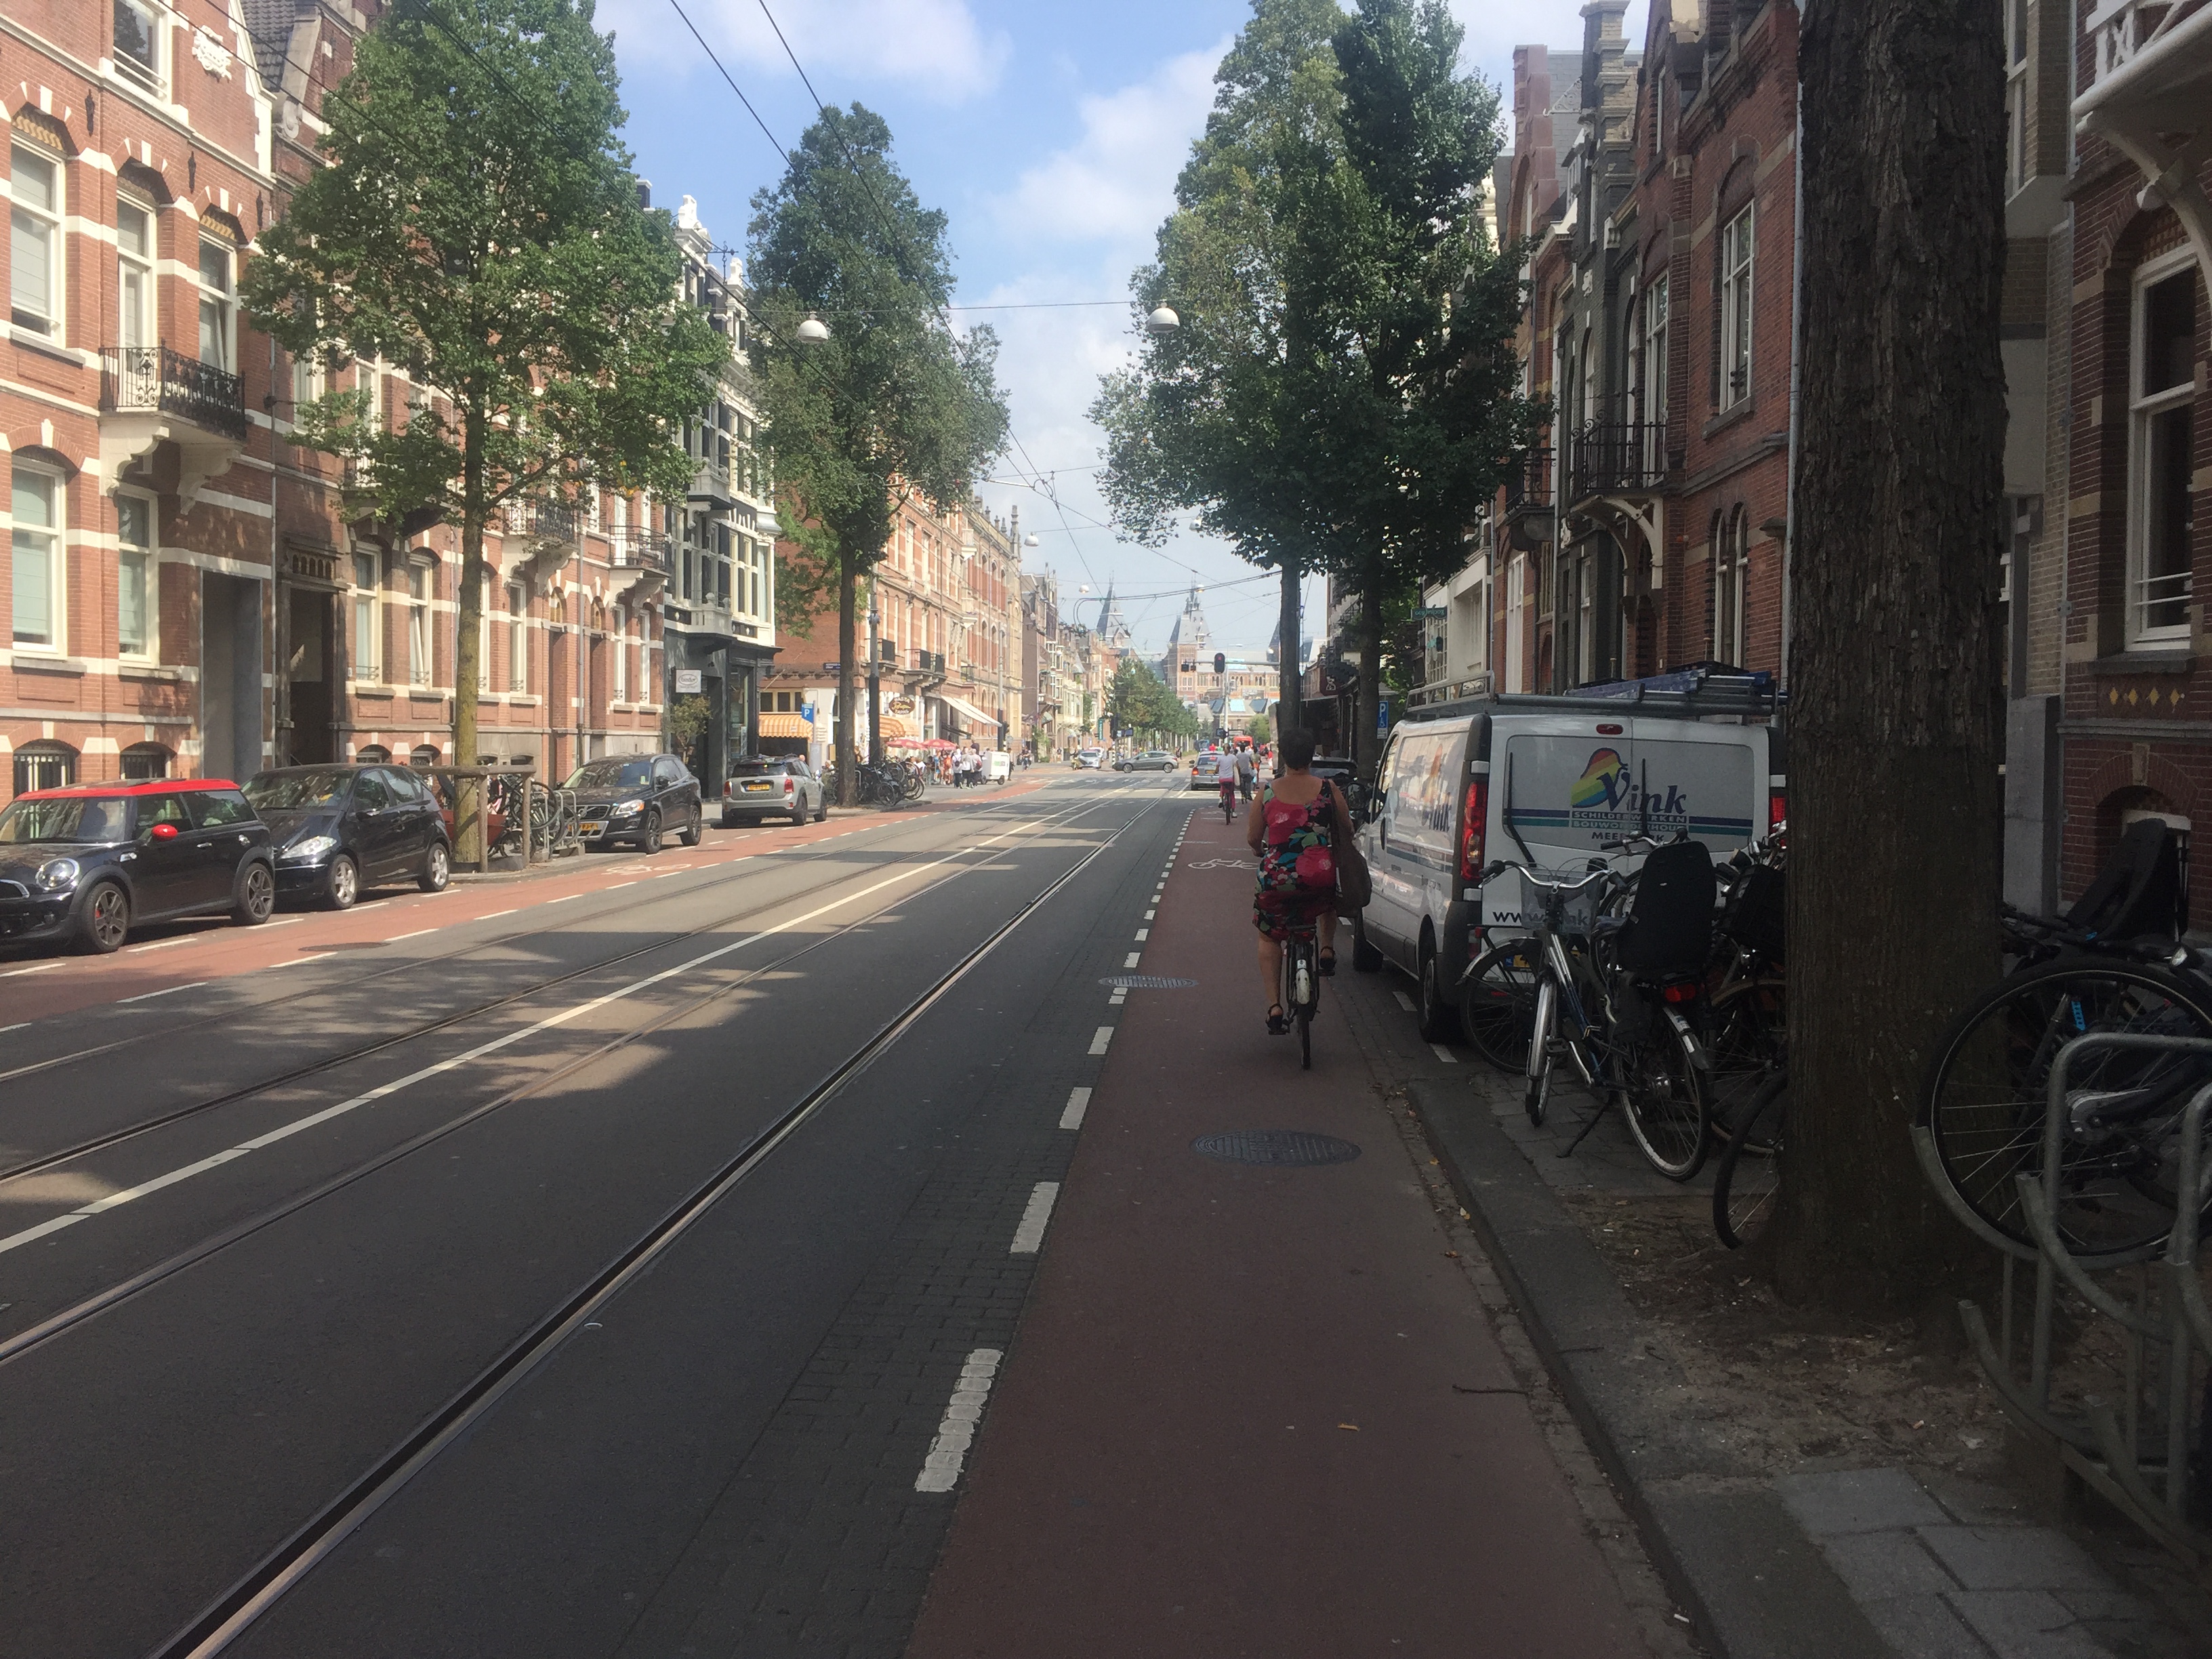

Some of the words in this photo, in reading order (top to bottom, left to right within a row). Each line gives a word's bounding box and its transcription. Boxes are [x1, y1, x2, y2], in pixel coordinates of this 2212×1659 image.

[804, 708, 811, 718] P
[1379, 703, 1387, 718] P
[1596, 772, 1687, 815] Vink
[1573, 811, 1685, 823] SCHILDERWRKEN
[1572, 821, 1685, 832] BOUWODEHOU
[1591, 832, 1665, 842] MEERK
